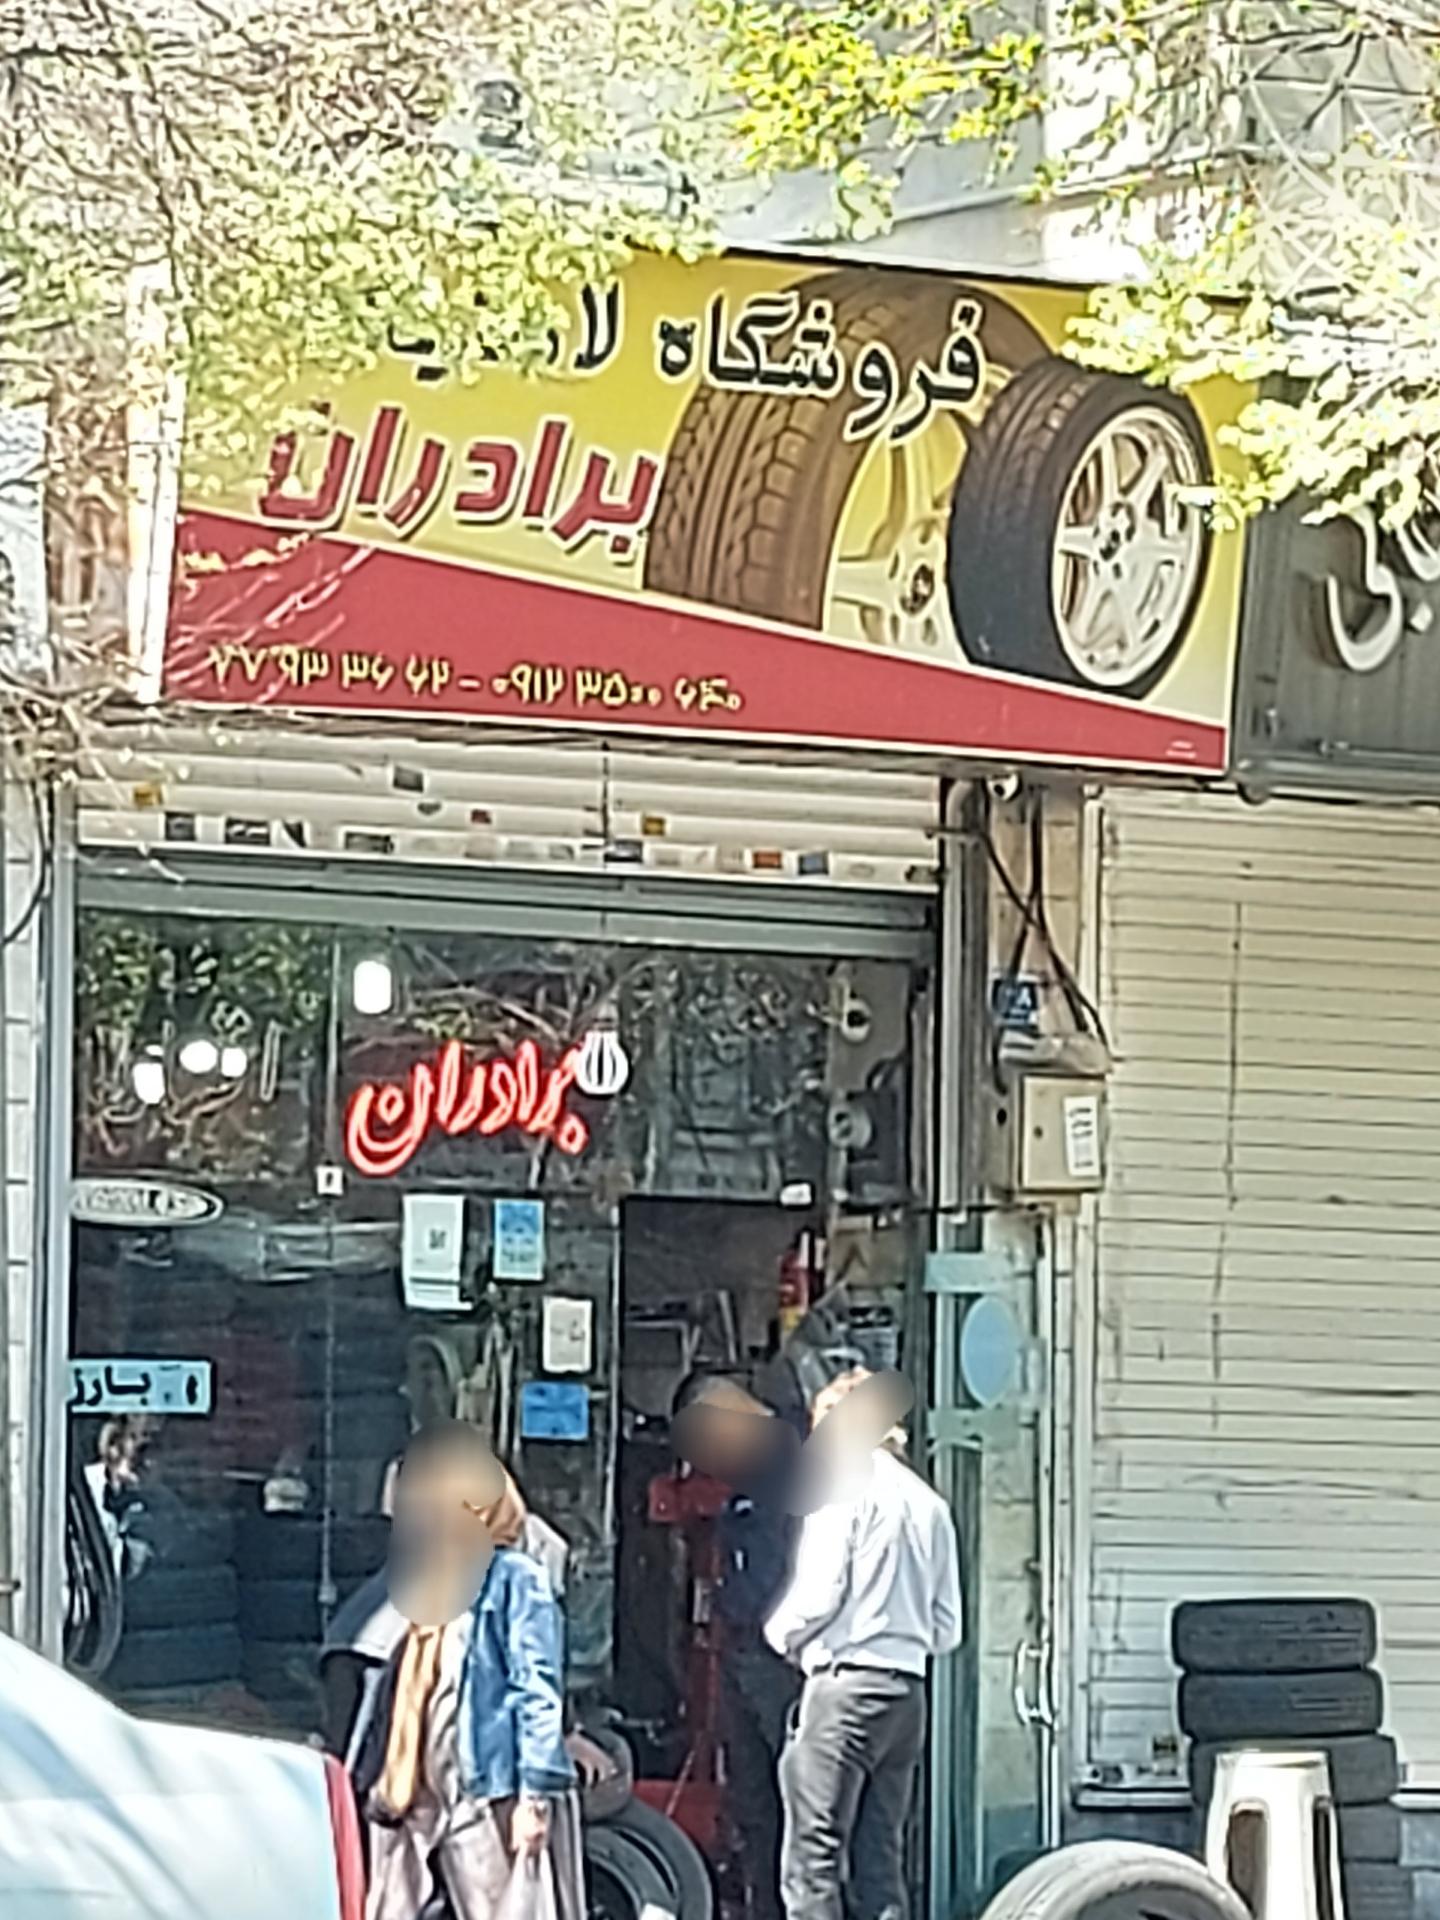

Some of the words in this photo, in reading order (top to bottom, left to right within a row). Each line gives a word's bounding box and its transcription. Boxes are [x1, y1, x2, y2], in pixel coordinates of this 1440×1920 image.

[659, 290, 982, 440] فروشگاه
[258, 400, 662, 556] برادران
[345, 1038, 590, 1176] برادران
[70, 1364, 152, 1407] بارز
